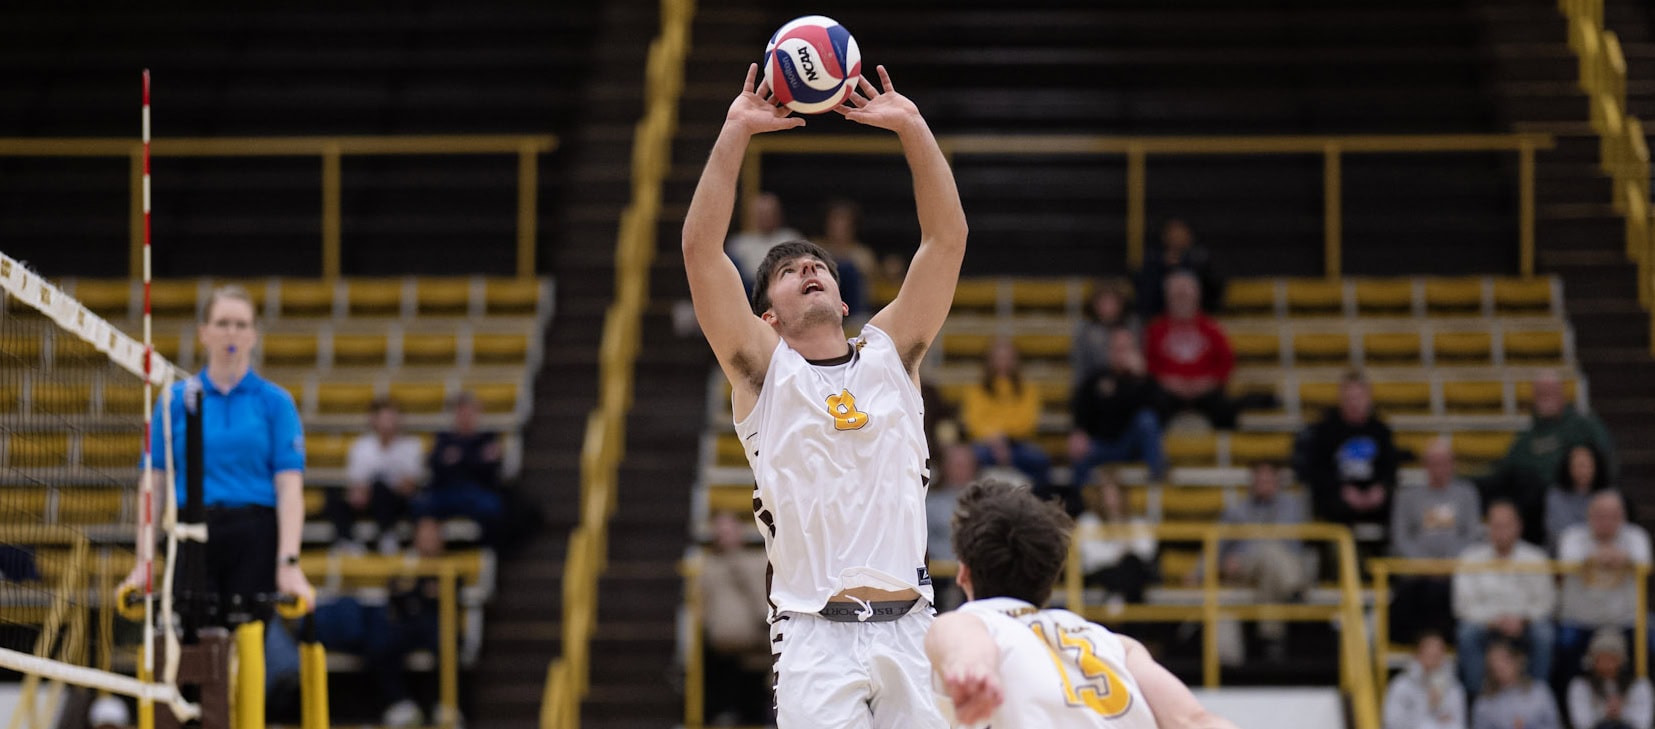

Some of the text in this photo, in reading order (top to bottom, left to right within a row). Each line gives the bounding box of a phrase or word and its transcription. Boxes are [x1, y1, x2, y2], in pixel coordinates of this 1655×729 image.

[798, 46, 819, 82] NCAA
[825, 388, 869, 431] 8
[1029, 620, 1132, 719] 13
